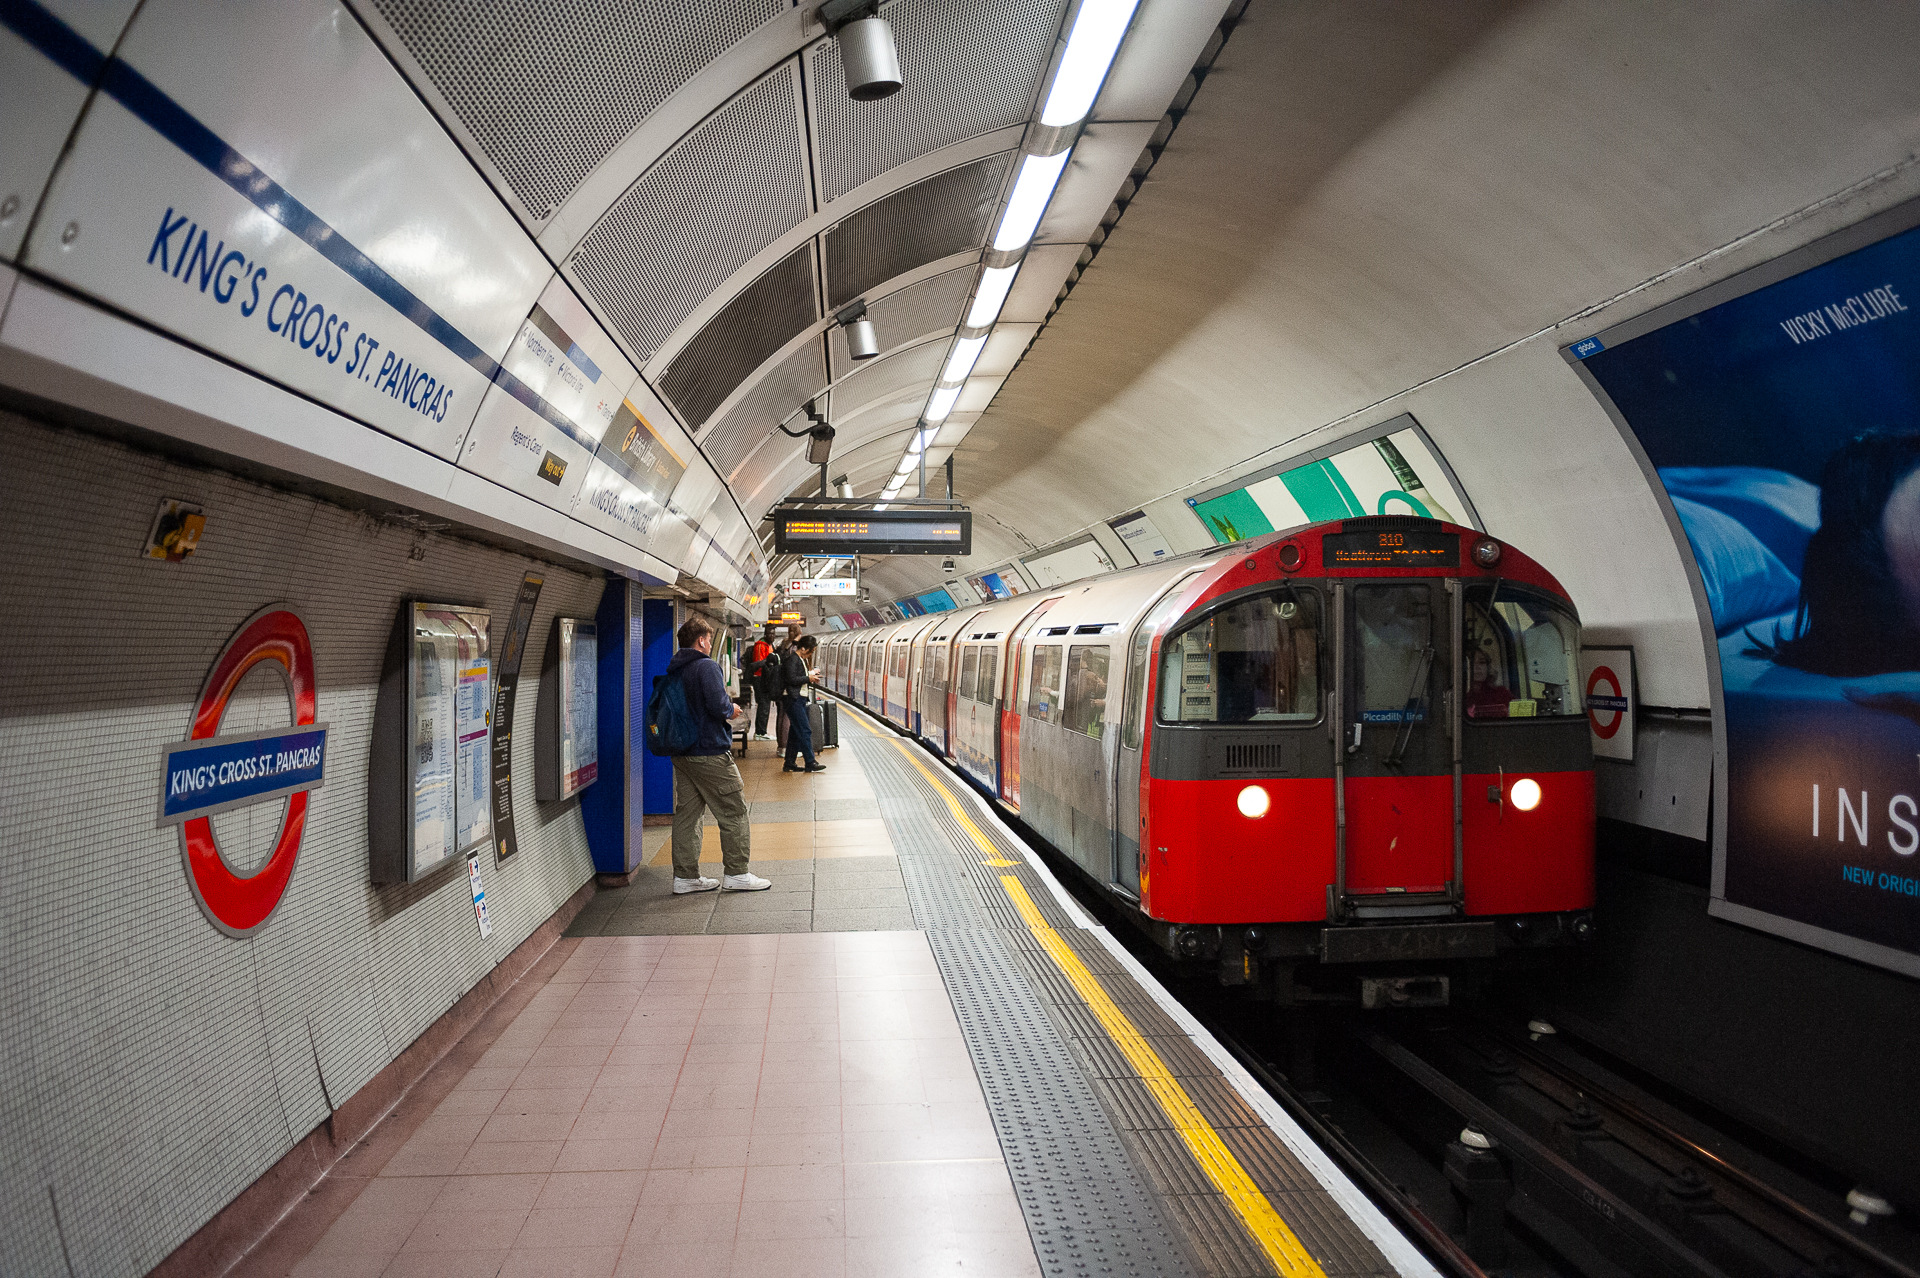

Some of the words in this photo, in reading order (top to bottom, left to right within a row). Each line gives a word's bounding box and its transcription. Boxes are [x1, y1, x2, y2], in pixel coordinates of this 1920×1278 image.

[147, 207, 267, 318] KING'S
[266, 283, 349, 364] CROSS
[345, 331, 380, 383] ST.
[373, 349, 454, 424] PANCRAS
[1780, 309, 1832, 344] VICKY
[1824, 284, 1908, 331] McCLURE
[1577, 339, 1597, 356] global
[171, 763, 216, 796] KING'S
[218, 756, 257, 785] CROSS
[258, 754, 273, 777] ST.
[275, 745, 321, 774] PANCRAS
[1843, 865, 1874, 887] NEW
